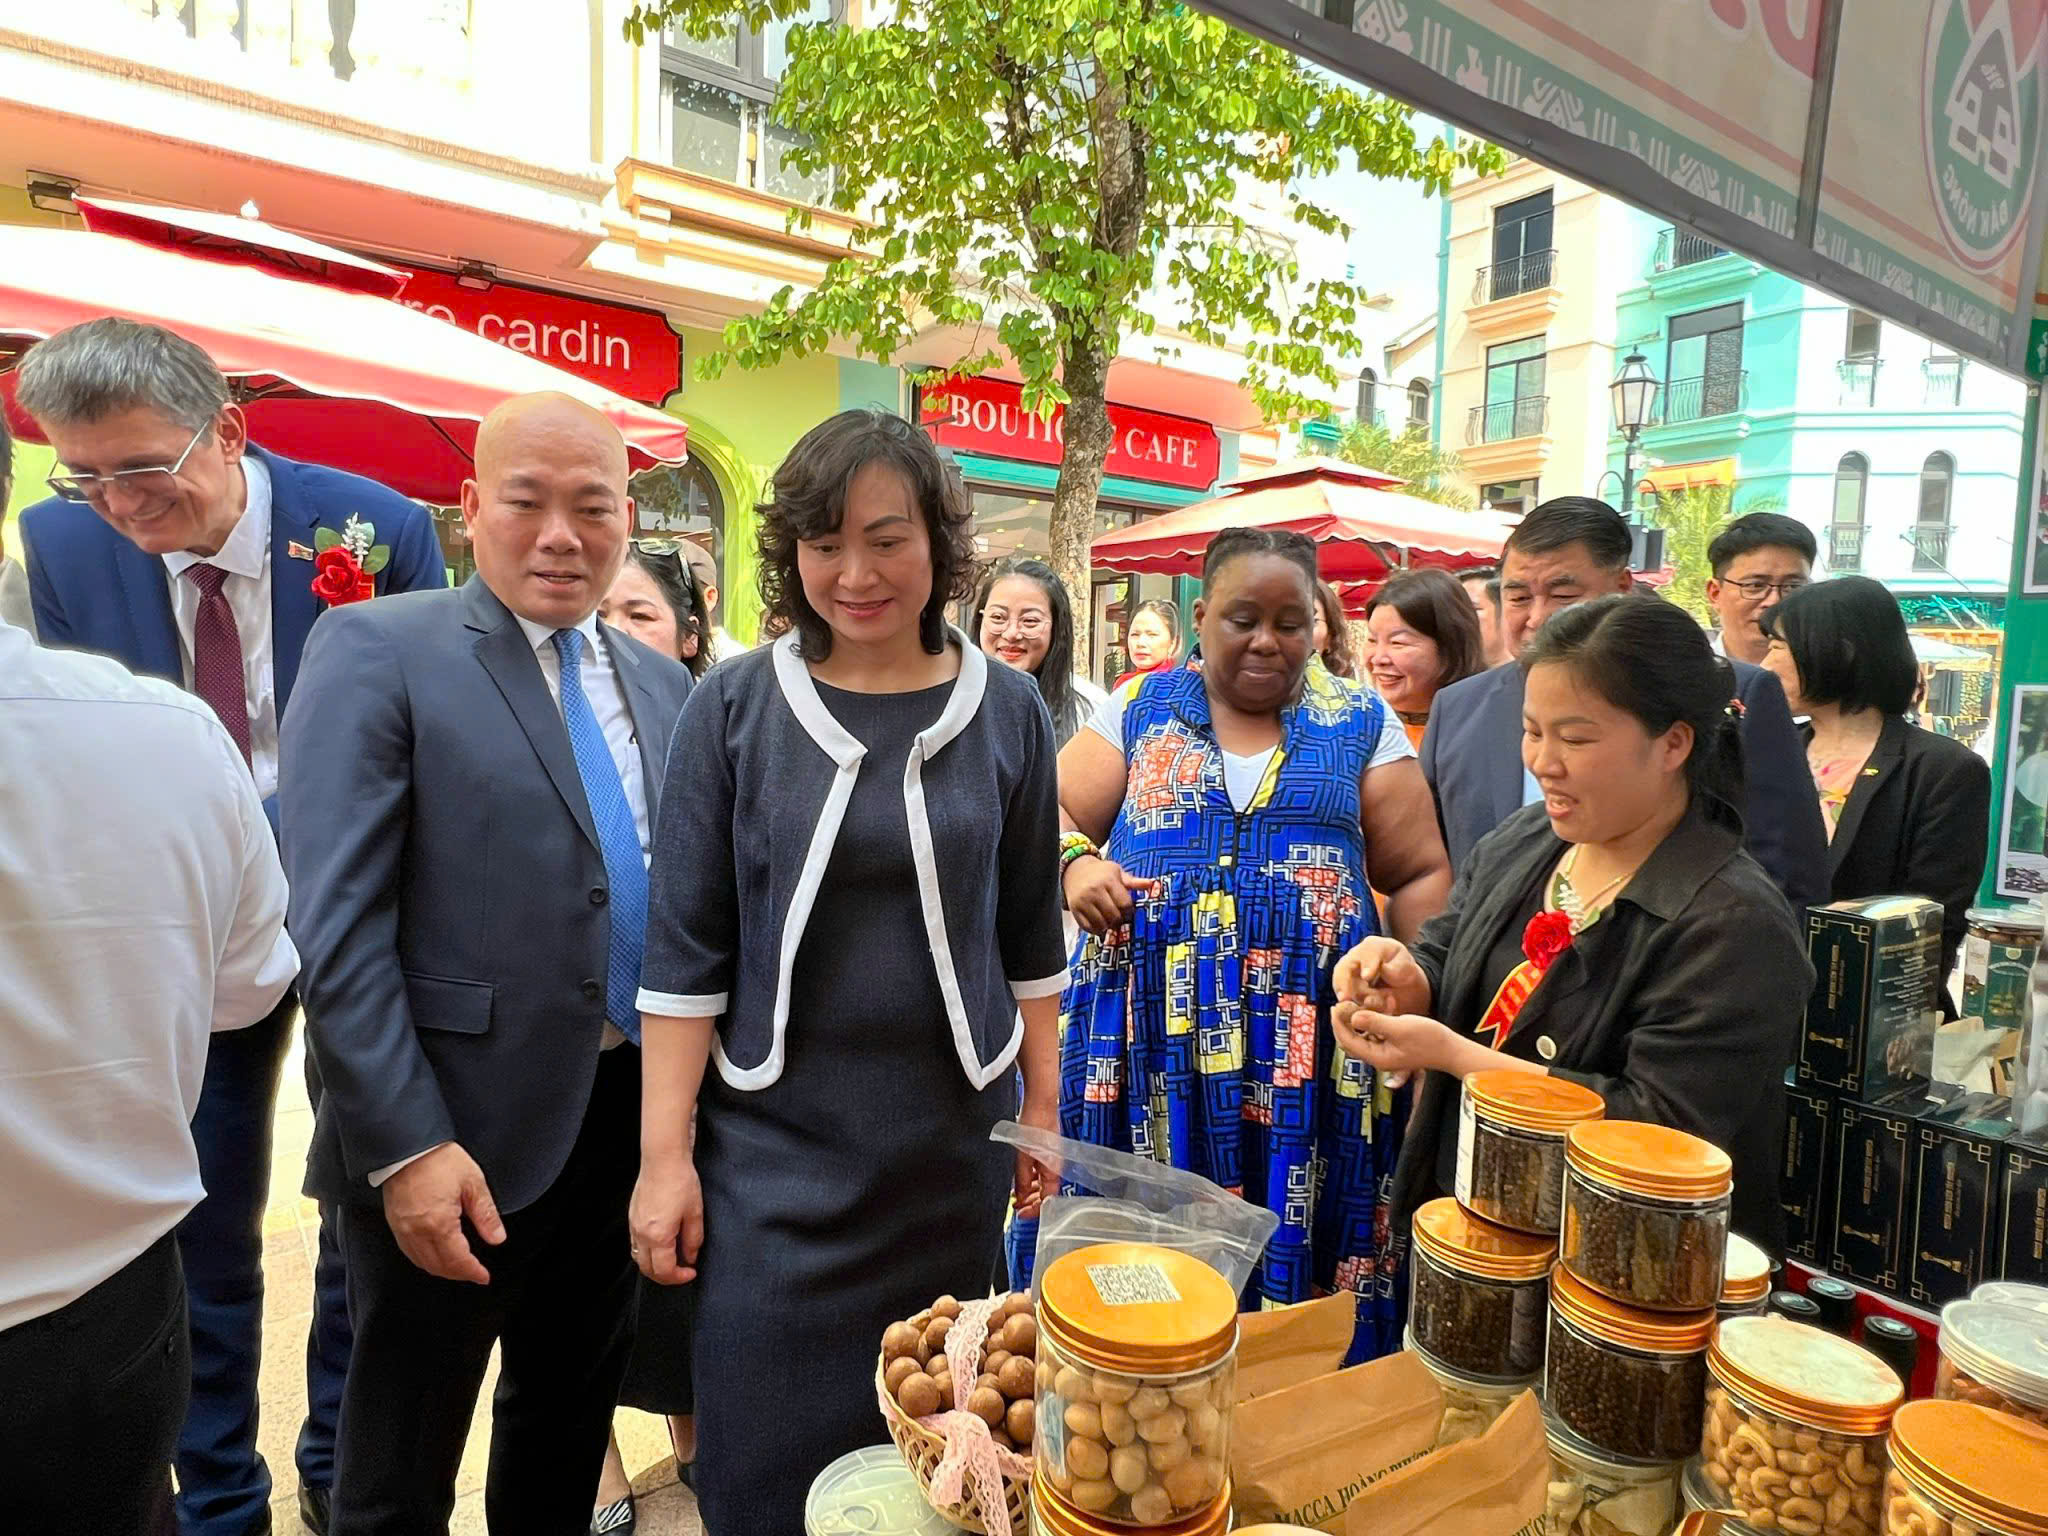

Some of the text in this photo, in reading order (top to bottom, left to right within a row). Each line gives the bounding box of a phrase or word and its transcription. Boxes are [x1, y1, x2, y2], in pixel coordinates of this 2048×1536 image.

[477, 312, 632, 371] cardin
[950, 393, 1198, 469] BOUTI CAFE
